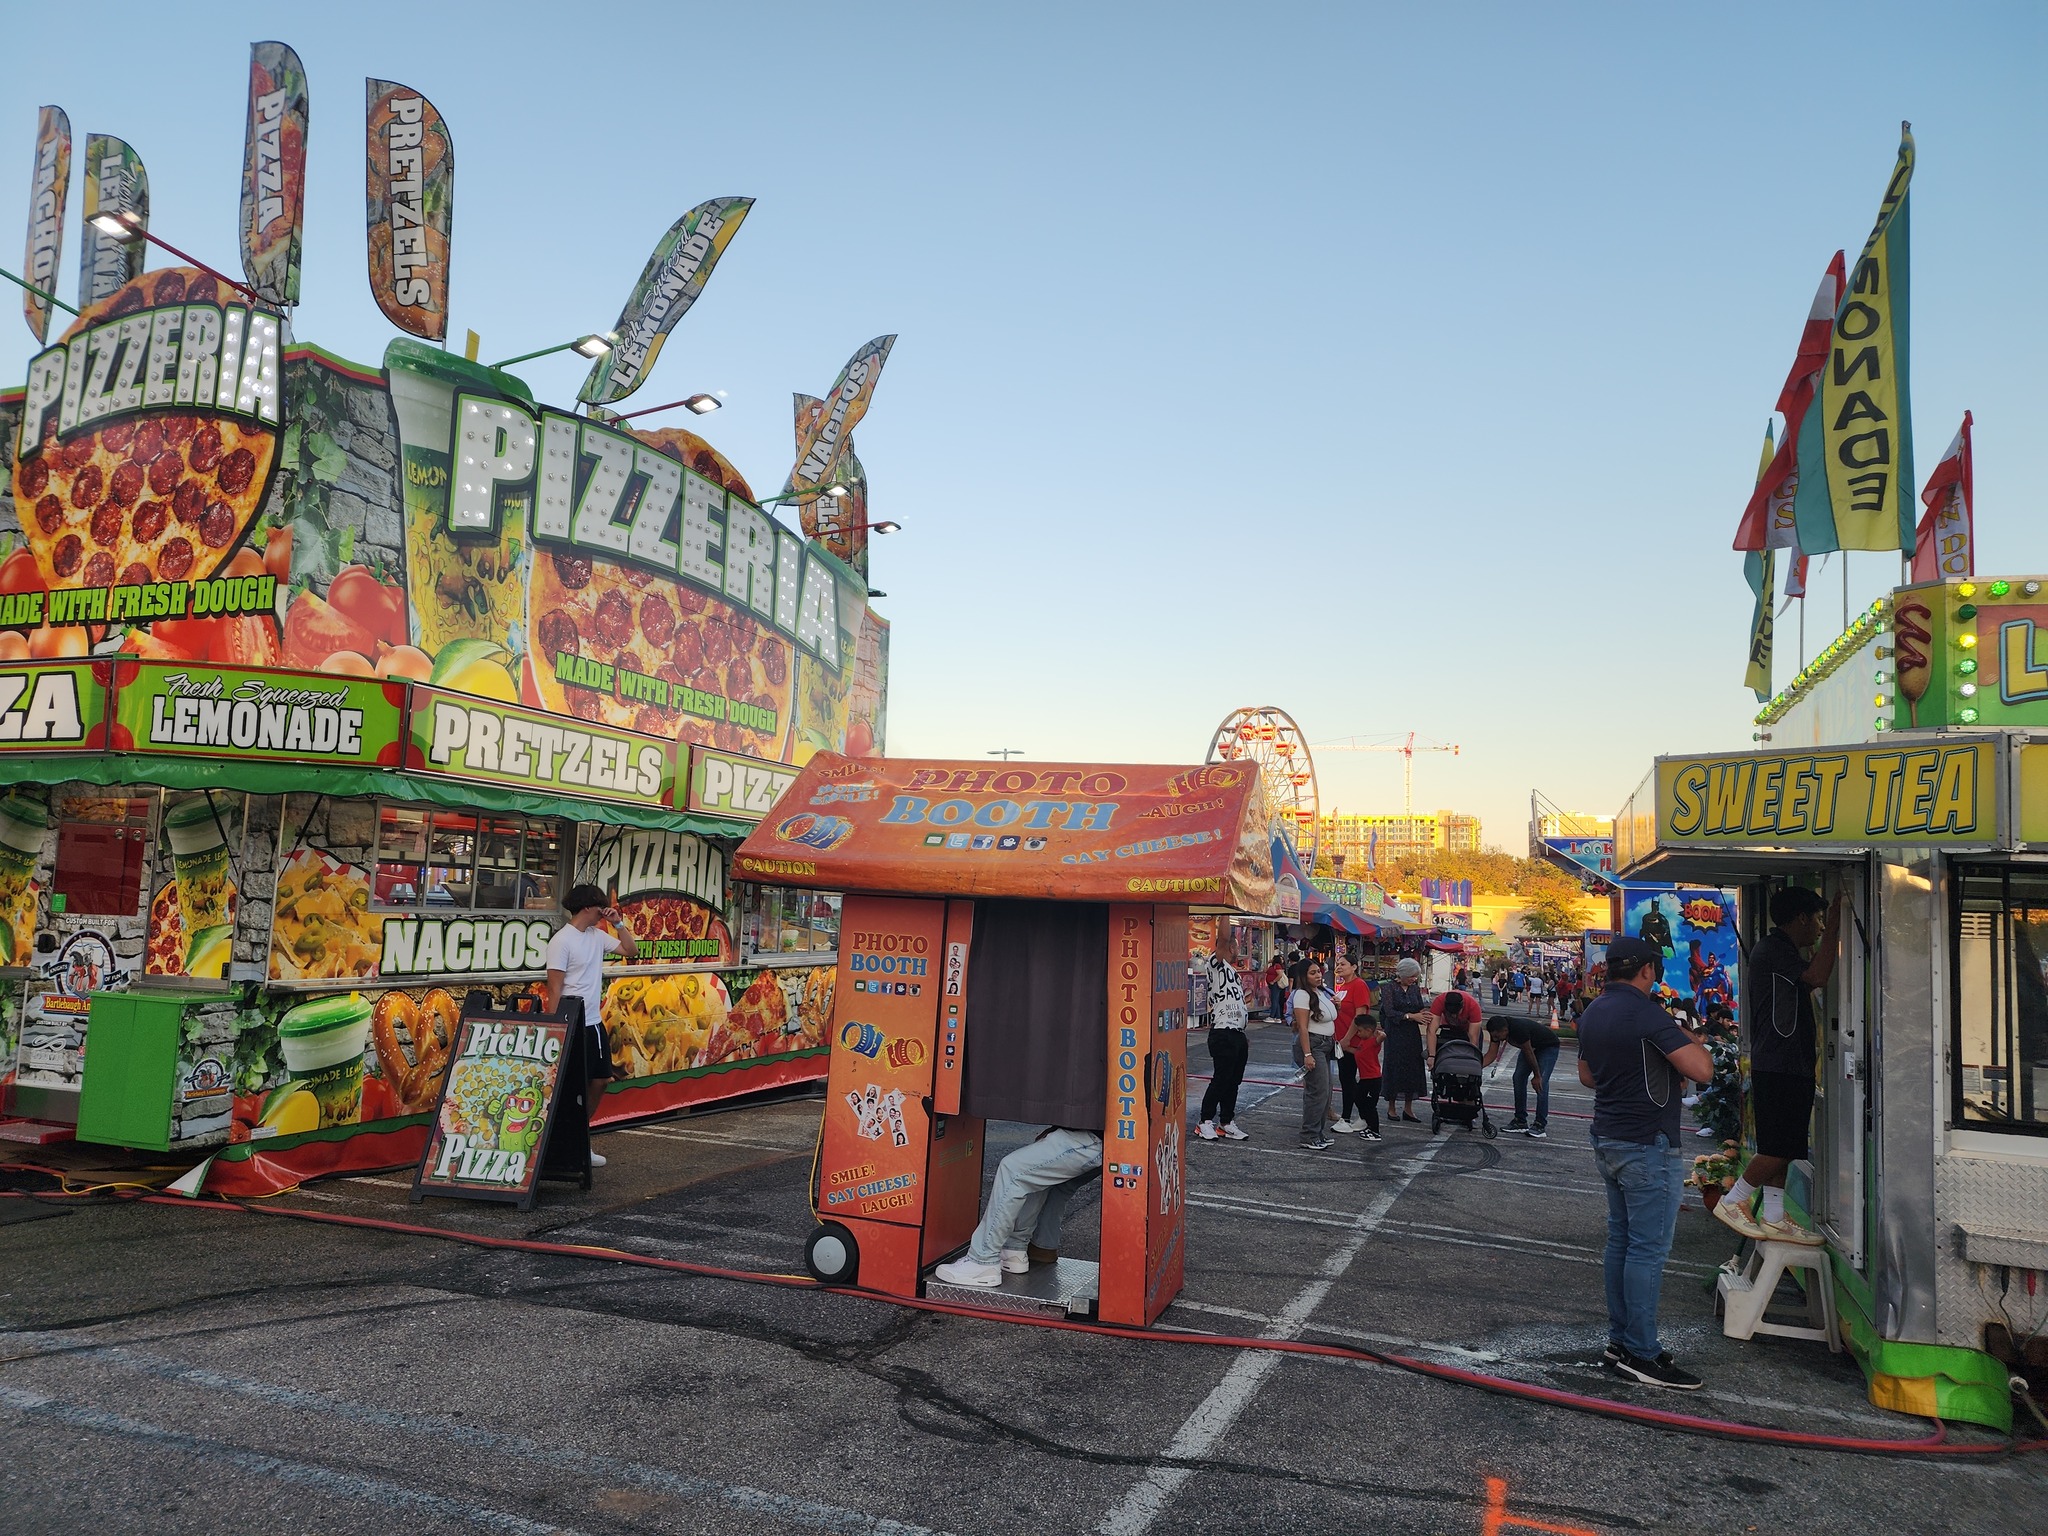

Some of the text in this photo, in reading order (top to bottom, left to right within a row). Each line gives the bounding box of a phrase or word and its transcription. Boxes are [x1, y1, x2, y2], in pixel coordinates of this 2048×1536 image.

[257, 88, 286, 235] PIZZA
[389, 97, 431, 307] PRETZELS
[609, 210, 726, 389] LEMONADE
[18, 304, 281, 460] PIZZERIA
[796, 359, 870, 485] NACHOS
[449, 393, 840, 672] PIZZERIA
[0, 575, 277, 627] ADE WITH FRESH DOUGH
[164, 673, 349, 711] Fresh Squeezed
[555, 651, 777, 734] MADE WITH FRESH DOUGH
[150, 695, 363, 755] LEMONADE
[430, 703, 662, 796] PRETZELS
[901, 769, 1127, 797] PHOTO
[1670, 746, 1978, 836] SWEET TEA
[879, 795, 1120, 831] BOOTH
[597, 830, 725, 915] PIZZERIA
[742, 858, 816, 876] CAUTION
[1061, 849, 1111, 866] SAY
[1127, 876, 1221, 893] CAUTION
[65, 917, 87, 926] CUSTOM
[87, 918, 103, 926] BUILT
[1684, 903, 1723, 923] BOOM!
[380, 919, 552, 974] NACHOS
[655, 939, 687, 958] FRESH
[688, 938, 720, 957] DOUGH
[850, 953, 928, 976] BOOTH
[852, 932, 929, 954] PHOTO
[1156, 960, 1187, 993] BOOTH
[461, 1021, 561, 1064] Pickle
[434, 1133, 527, 1186] Pizza
[827, 1187, 856, 1205] SAY
